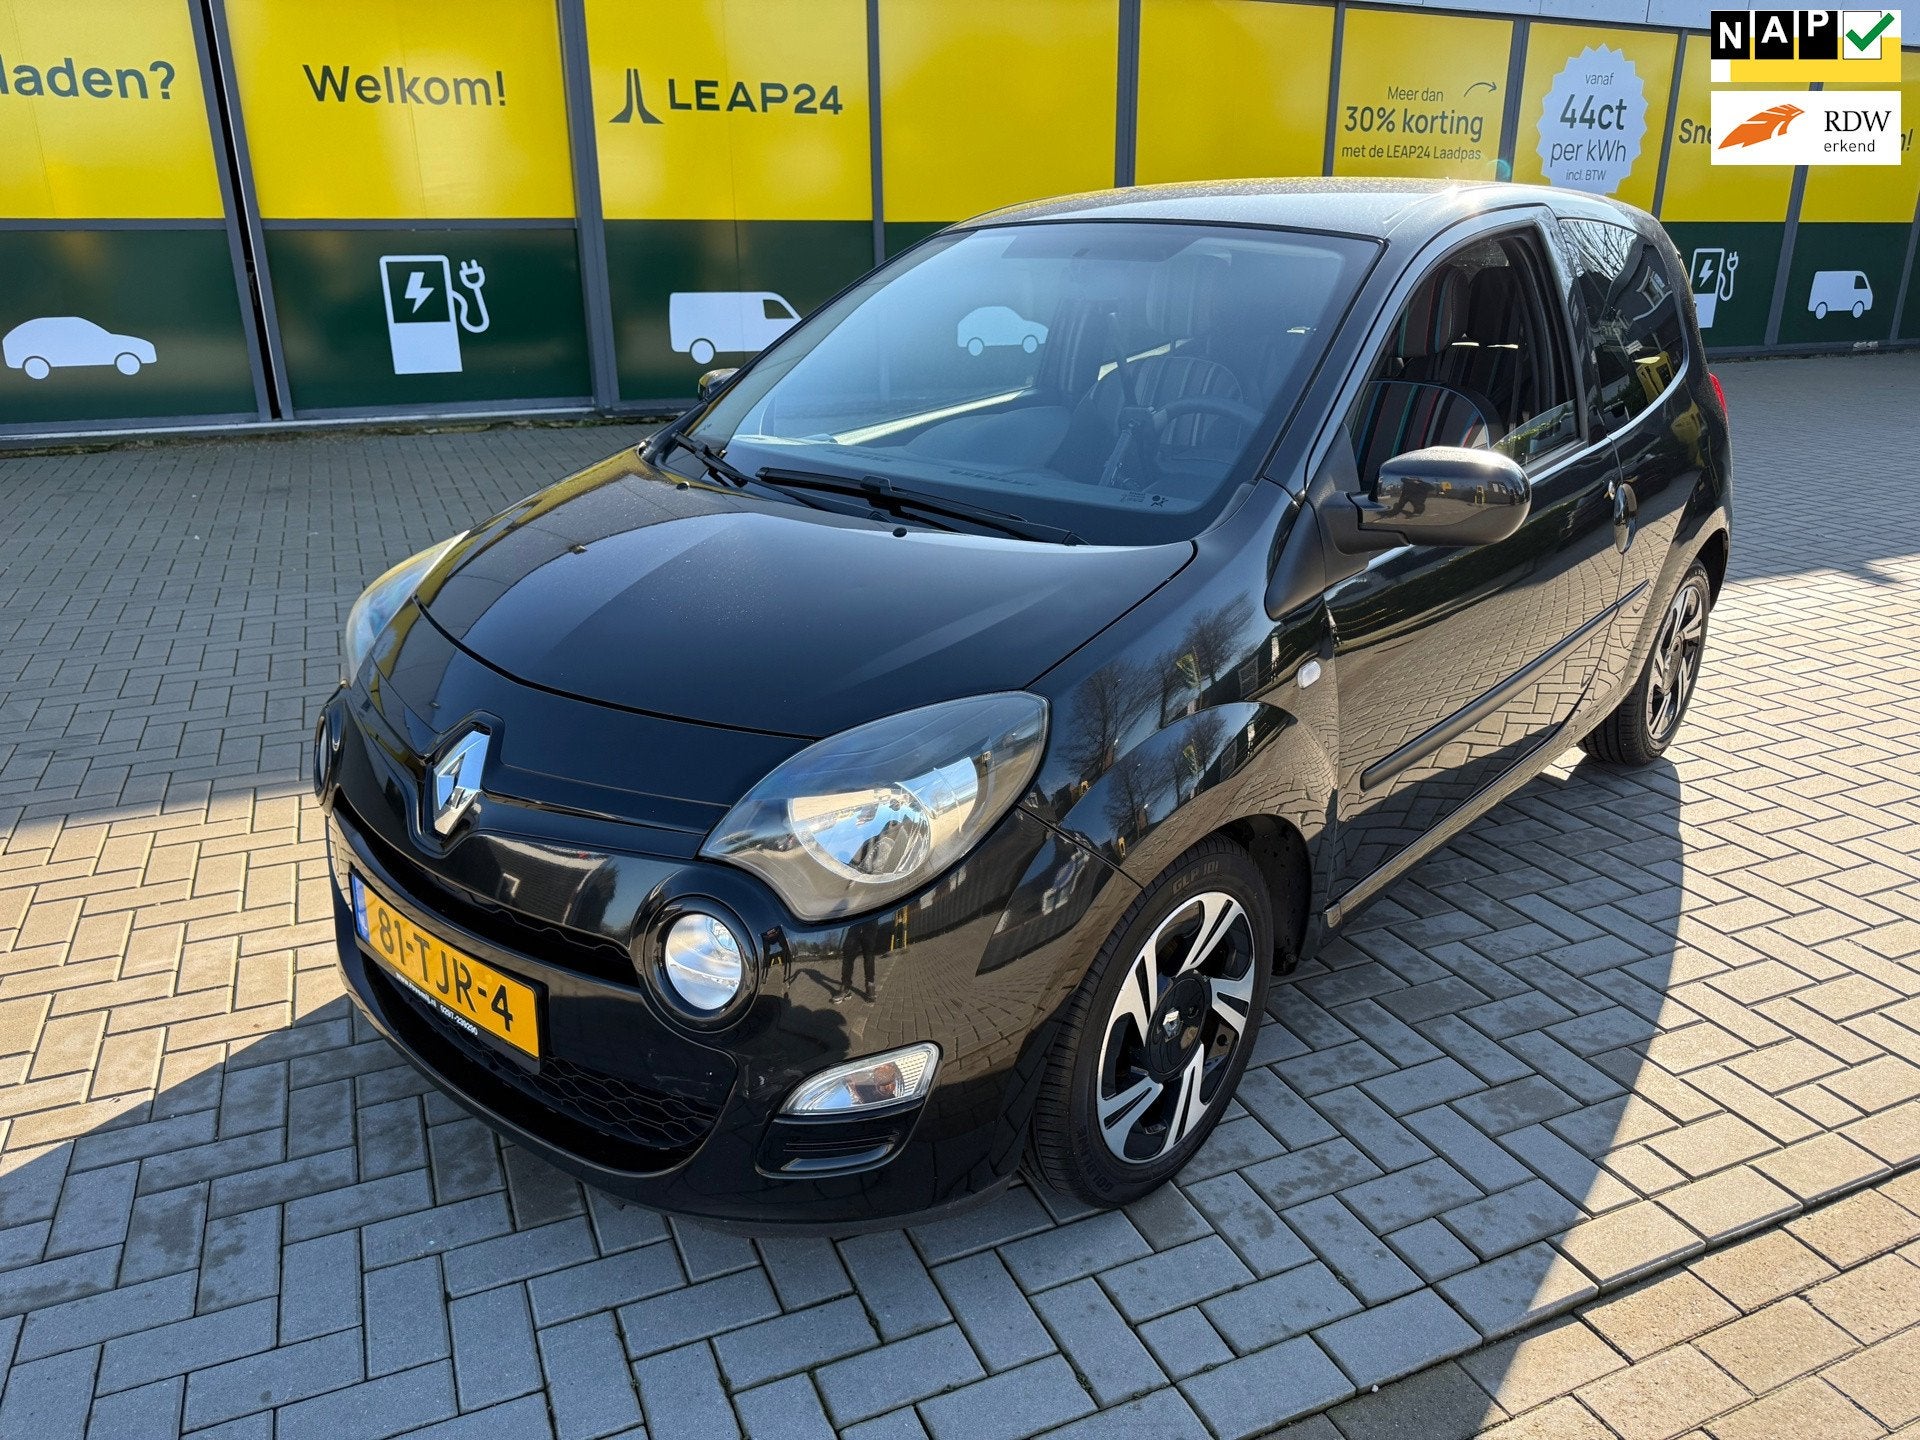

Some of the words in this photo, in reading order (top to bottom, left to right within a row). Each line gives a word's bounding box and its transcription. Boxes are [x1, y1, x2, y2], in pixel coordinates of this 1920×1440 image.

[0, 54, 176, 100] laden?
[303, 65, 506, 107] Welkom!
[1387, 86, 1420, 101] Meer
[1421, 87, 1444, 102] dan
[1585, 72, 1615, 86] vanaf
[669, 78, 843, 115] LEAP24
[1560, 94, 1627, 130] 44ct
[1344, 106, 1396, 132] 30%
[1402, 108, 1484, 143] korting
[1341, 145, 1366, 158] met
[1368, 145, 1384, 158] de
[1386, 145, 1431, 159] LEAP24
[1433, 146, 1482, 163] Laadpas
[1550, 142, 1583, 167] per
[1586, 139, 1627, 162] kWh
[1565, 170, 1584, 181] incl.
[1585, 169, 1607, 181] BTW
[377, 907, 514, 1032] 81-TJR-4
